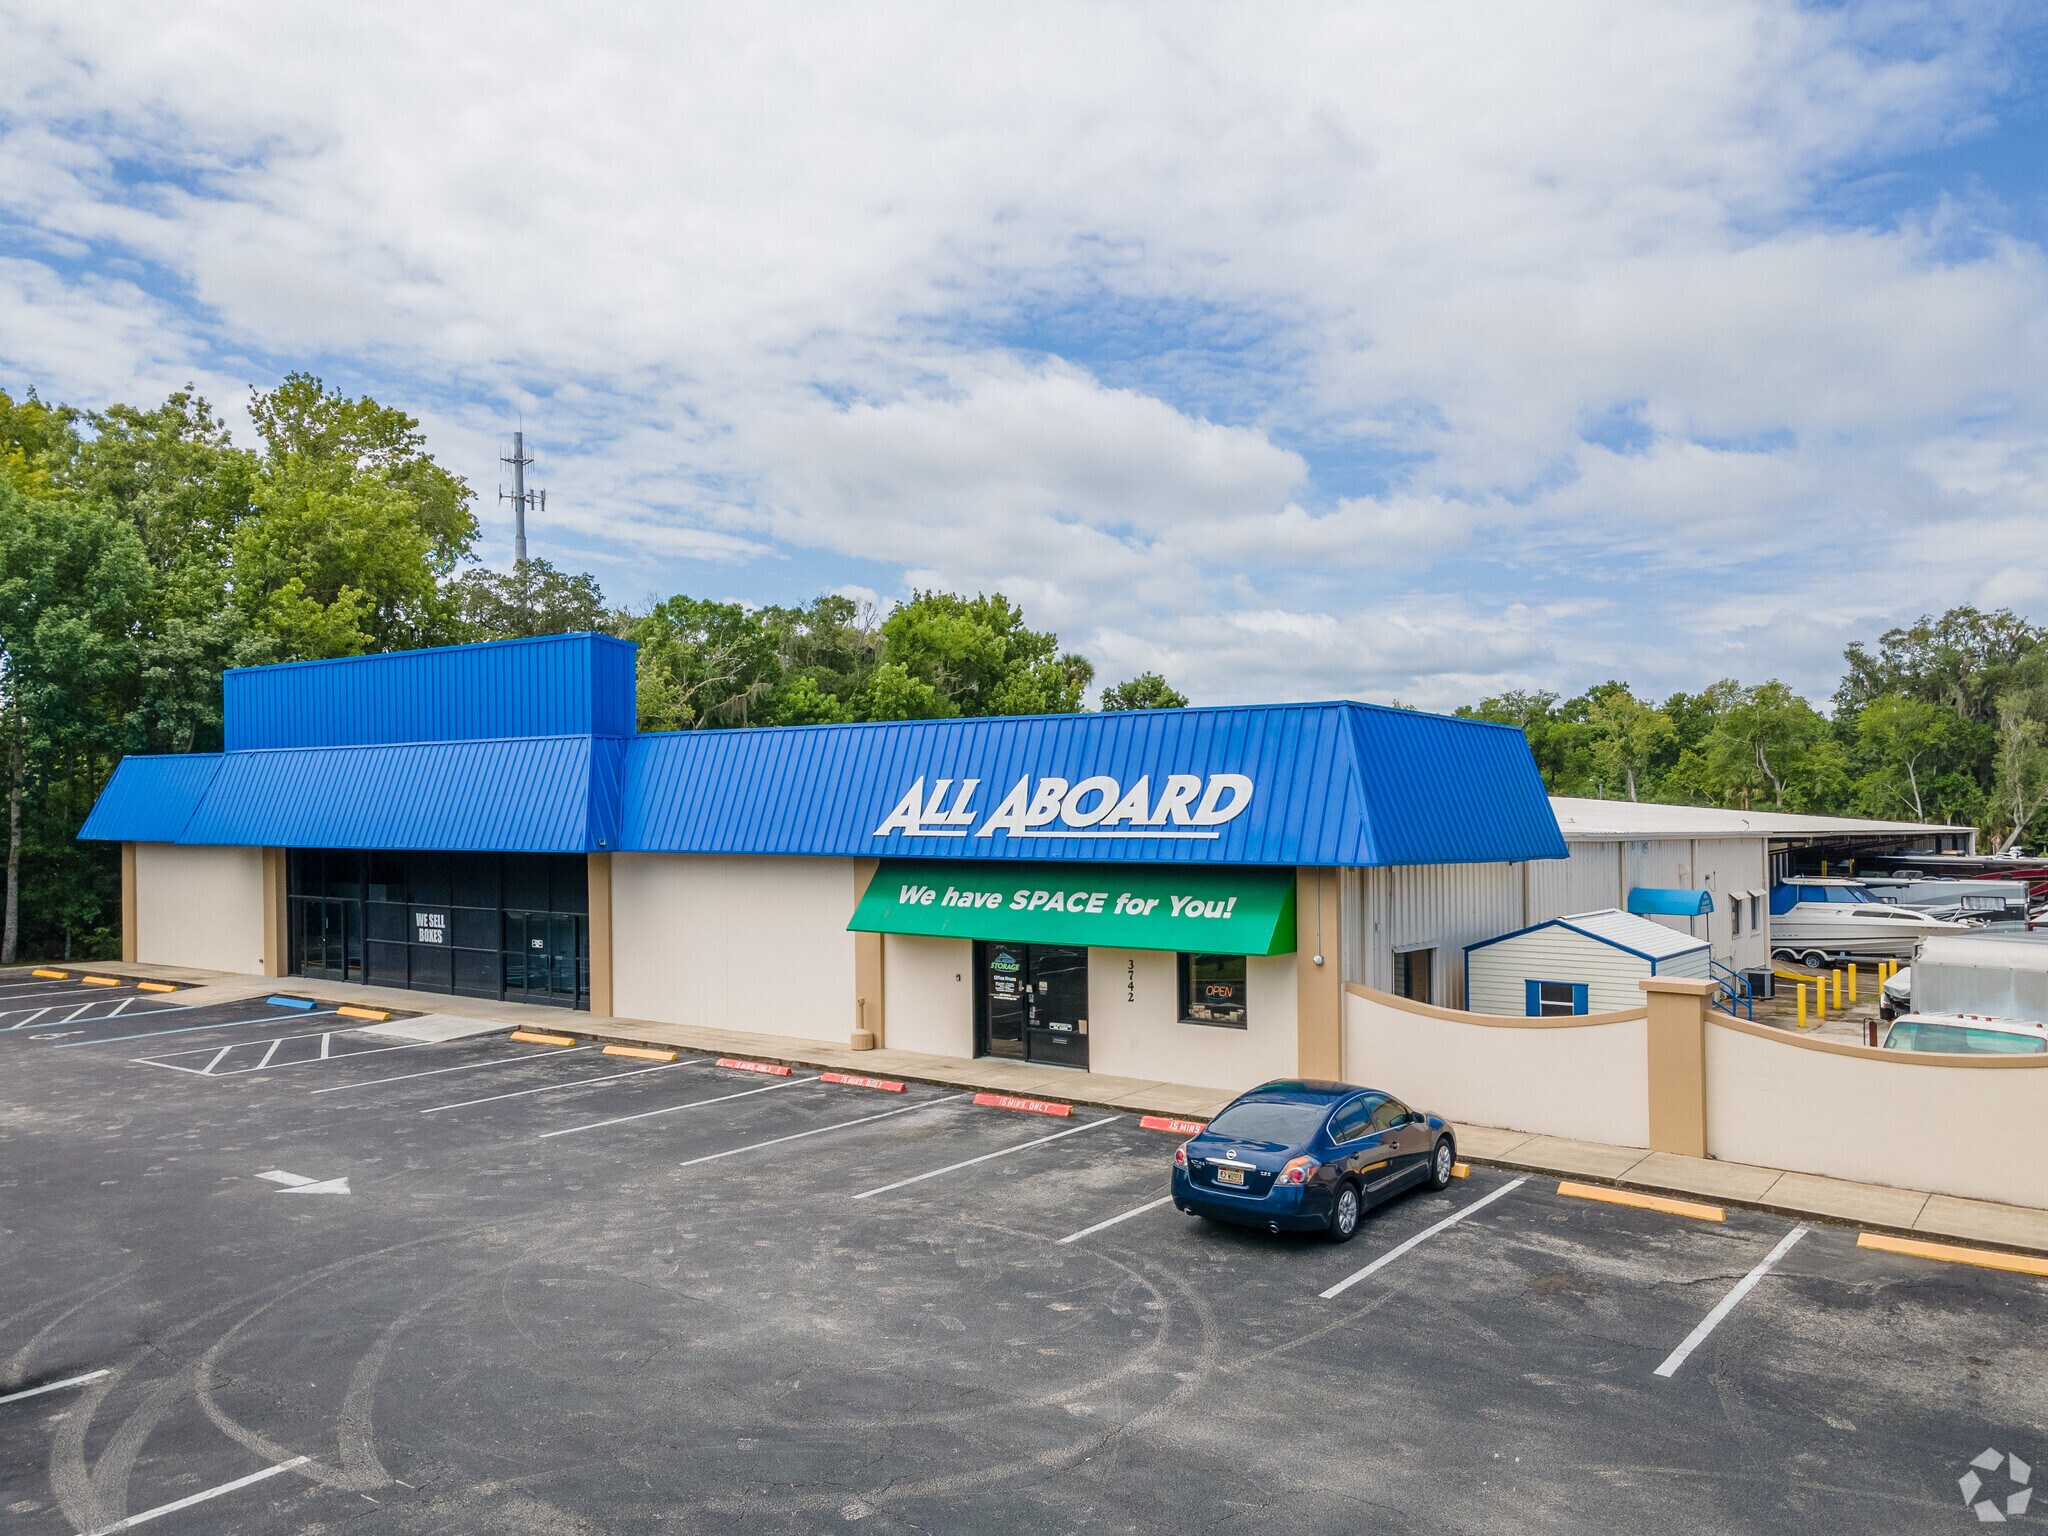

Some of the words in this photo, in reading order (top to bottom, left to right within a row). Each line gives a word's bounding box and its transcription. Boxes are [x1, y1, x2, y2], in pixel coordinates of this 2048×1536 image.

[872, 775, 981, 837] ALL
[974, 773, 1254, 839] ABOARD
[898, 884, 937, 906] We
[941, 886, 1003, 909] have
[1008, 889, 1109, 914] SPACE
[1113, 892, 1160, 916] for
[1170, 895, 1238, 919] You!
[416, 913, 428, 926] WE
[429, 914, 445, 928] SELL
[419, 928, 442, 943] BOXES
[991, 962, 1020, 971] STORAGE
[1127, 959, 1135, 1003] 3742
[1205, 985, 1233, 997] OPEN
[999, 1098, 1006, 1106] 15
[1028, 1102, 1049, 1111] ONLY
[1169, 1121, 1178, 1130] 15
